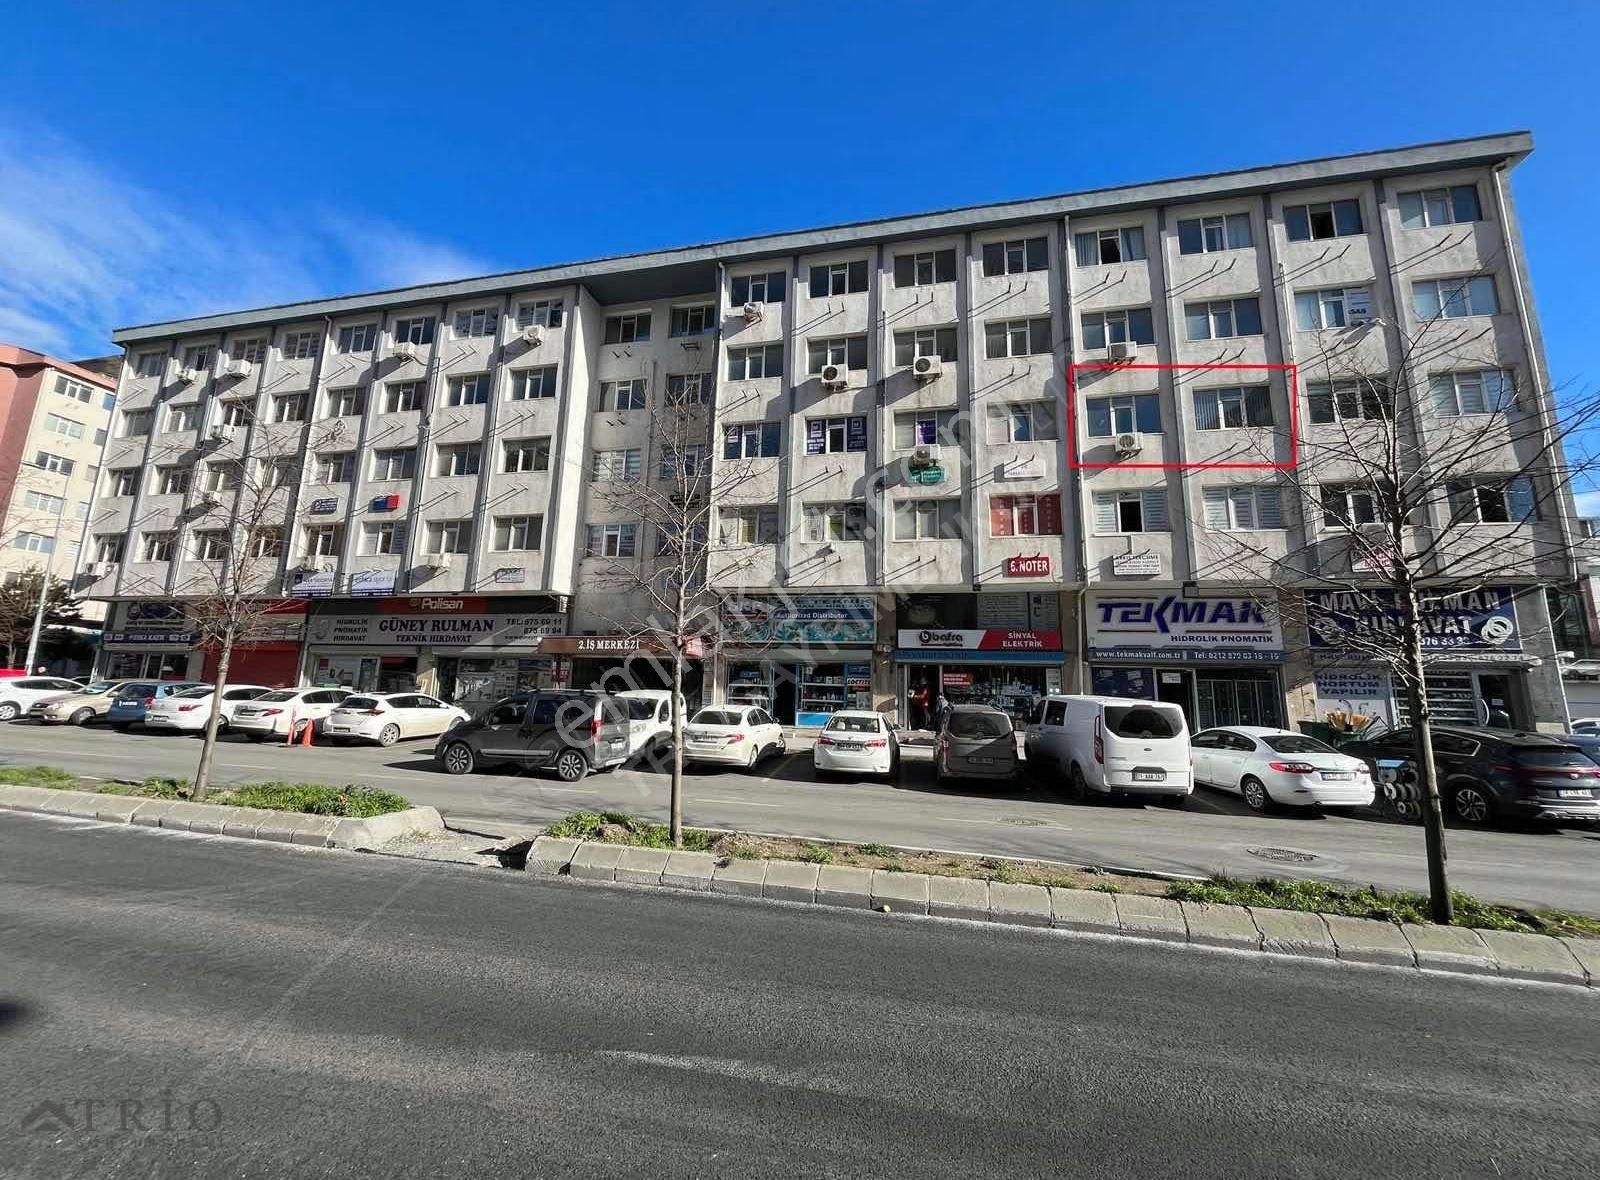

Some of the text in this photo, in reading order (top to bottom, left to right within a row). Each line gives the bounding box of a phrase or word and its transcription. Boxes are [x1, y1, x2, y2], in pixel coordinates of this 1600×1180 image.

[1010, 560, 1049, 573] 6. NOTER
[421, 597, 464, 610] Polisan
[1096, 596, 1266, 633] TEKMAK
[379, 616, 495, 632] GÜNEY RULMAN
[396, 633, 427, 643] TEKNİK
[932, 631, 963, 642] bafra
[596, 638, 640, 650] MERKEZİ
[1002, 639, 1043, 648] ELEKTRİK
